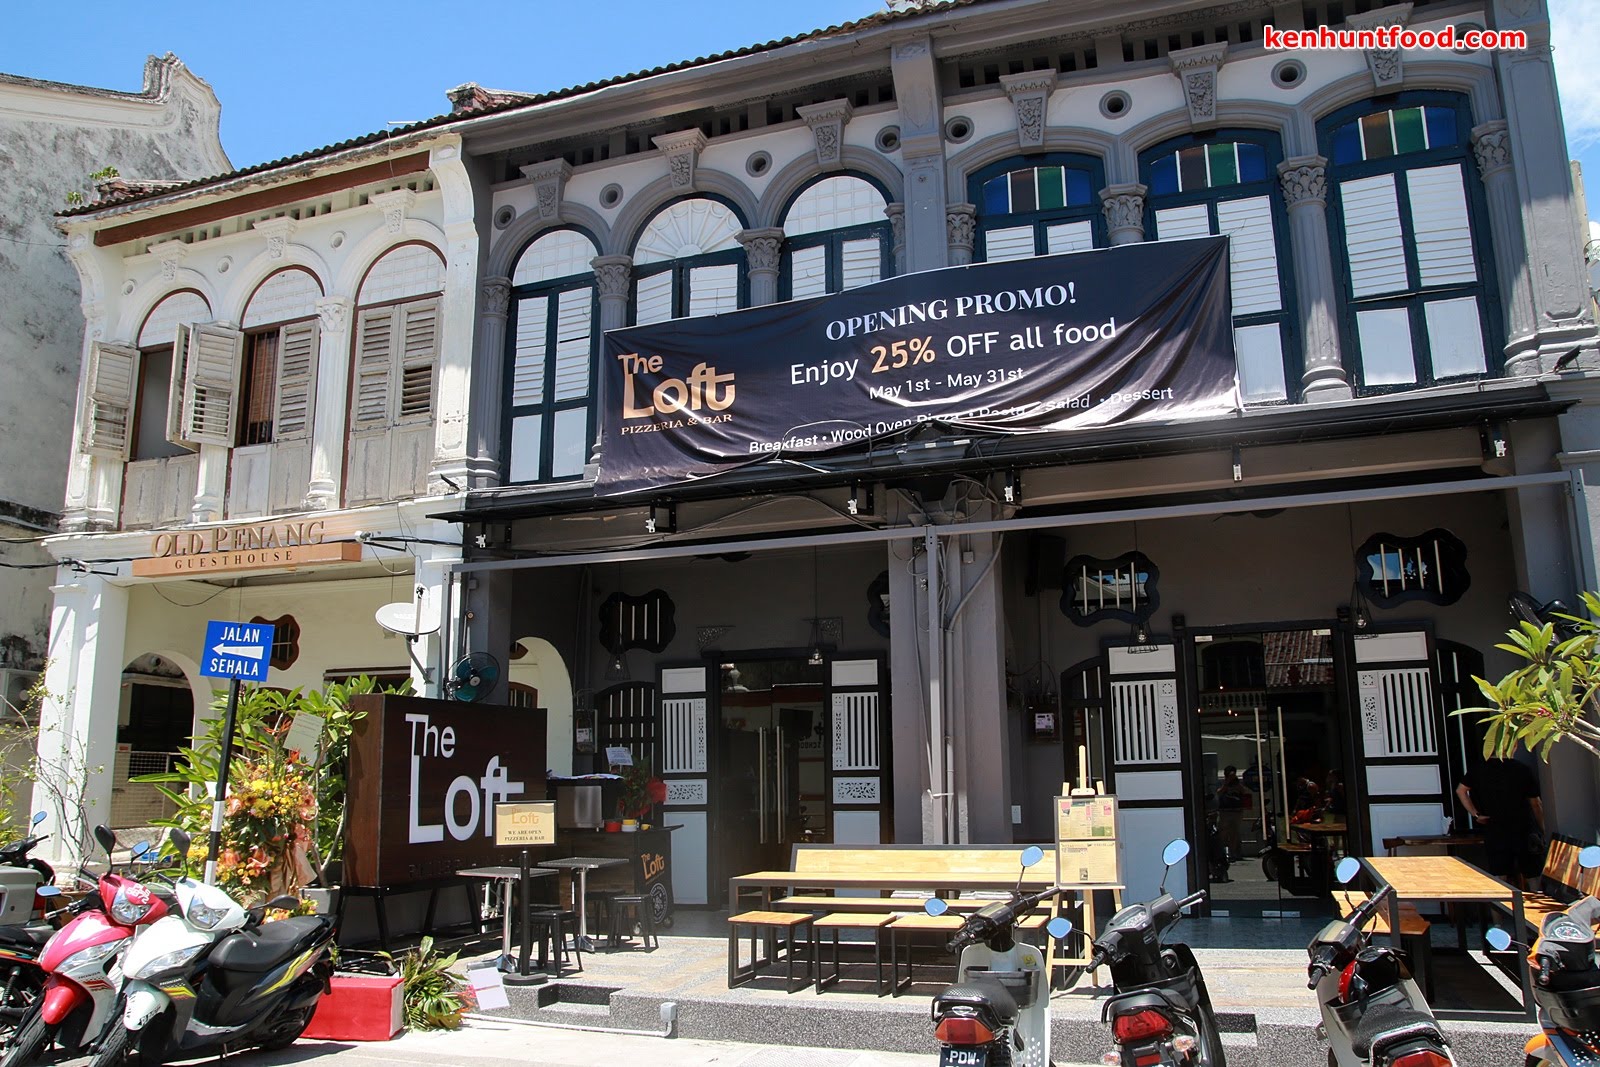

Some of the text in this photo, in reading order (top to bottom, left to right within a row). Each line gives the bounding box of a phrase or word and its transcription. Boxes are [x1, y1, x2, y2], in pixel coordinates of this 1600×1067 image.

[826, 281, 1077, 341] OPENING PROMO!
[618, 353, 663, 374] The
[791, 317, 1116, 386] Enjoy 25% OFF all food
[623, 362, 735, 419] Loft
[869, 385, 901, 399] May
[906, 378, 931, 393] 1st
[947, 373, 982, 389] May
[987, 367, 1024, 384] 31st
[621, 414, 733, 436] PIZZERIA & BAR
[749, 434, 818, 453] Breakfast
[831, 424, 872, 443] Wood
[875, 418, 912, 434] Oven
[1110, 387, 1174, 404] Dessert
[151, 521, 325, 558] OLD PENANG
[174, 550, 293, 570] GUESTHOUSE
[220, 626, 260, 643] JALAN
[209, 657, 259, 676] SEHALA
[405, 713, 456, 758] The
[408, 755, 525, 844] Loft
[511, 811, 539, 825] Loft
[641, 853, 651, 862] The
[643, 853, 665, 880] Loft
[948, 1050, 977, 1065] PDW
